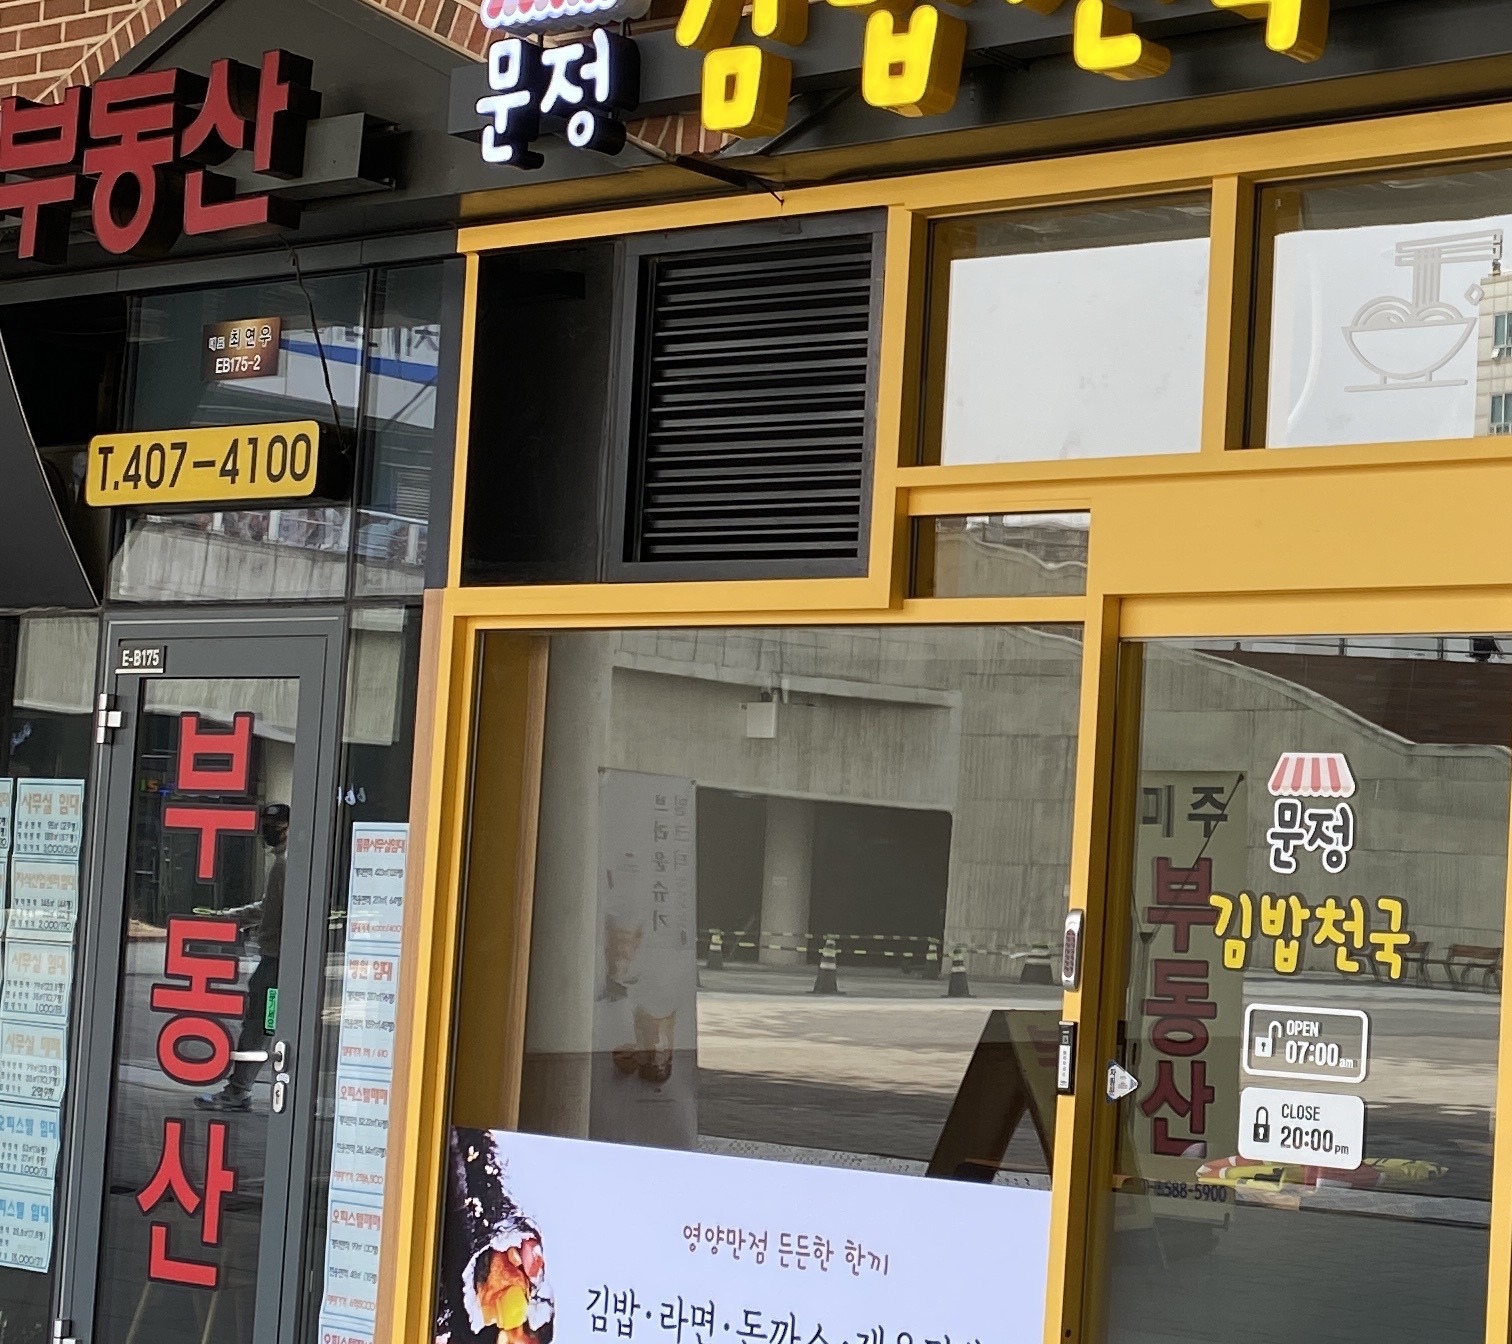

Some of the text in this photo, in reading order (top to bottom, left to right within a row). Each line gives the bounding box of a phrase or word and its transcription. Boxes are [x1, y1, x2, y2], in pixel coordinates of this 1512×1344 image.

[476, 27, 611, 163] 문정
[0, 50, 290, 258] 부동산
[215, 355, 261, 373] EB175-2
[98, 432, 312, 492] T.407-4100
[122, 649, 160, 666] E-B175
[1142, 785, 1229, 838] 미주
[1266, 798, 1355, 874] 문정
[1208, 893, 1411, 979] 김밥천국
[136, 710, 260, 1289] 부동산
[1141, 856, 1221, 1158] 부동산
[1286, 1020, 1319, 1038] OPEN
[1281, 1103, 1321, 1122] CLOSE
[682, 1223, 890, 1277] 영양만점 든든한 한끼
